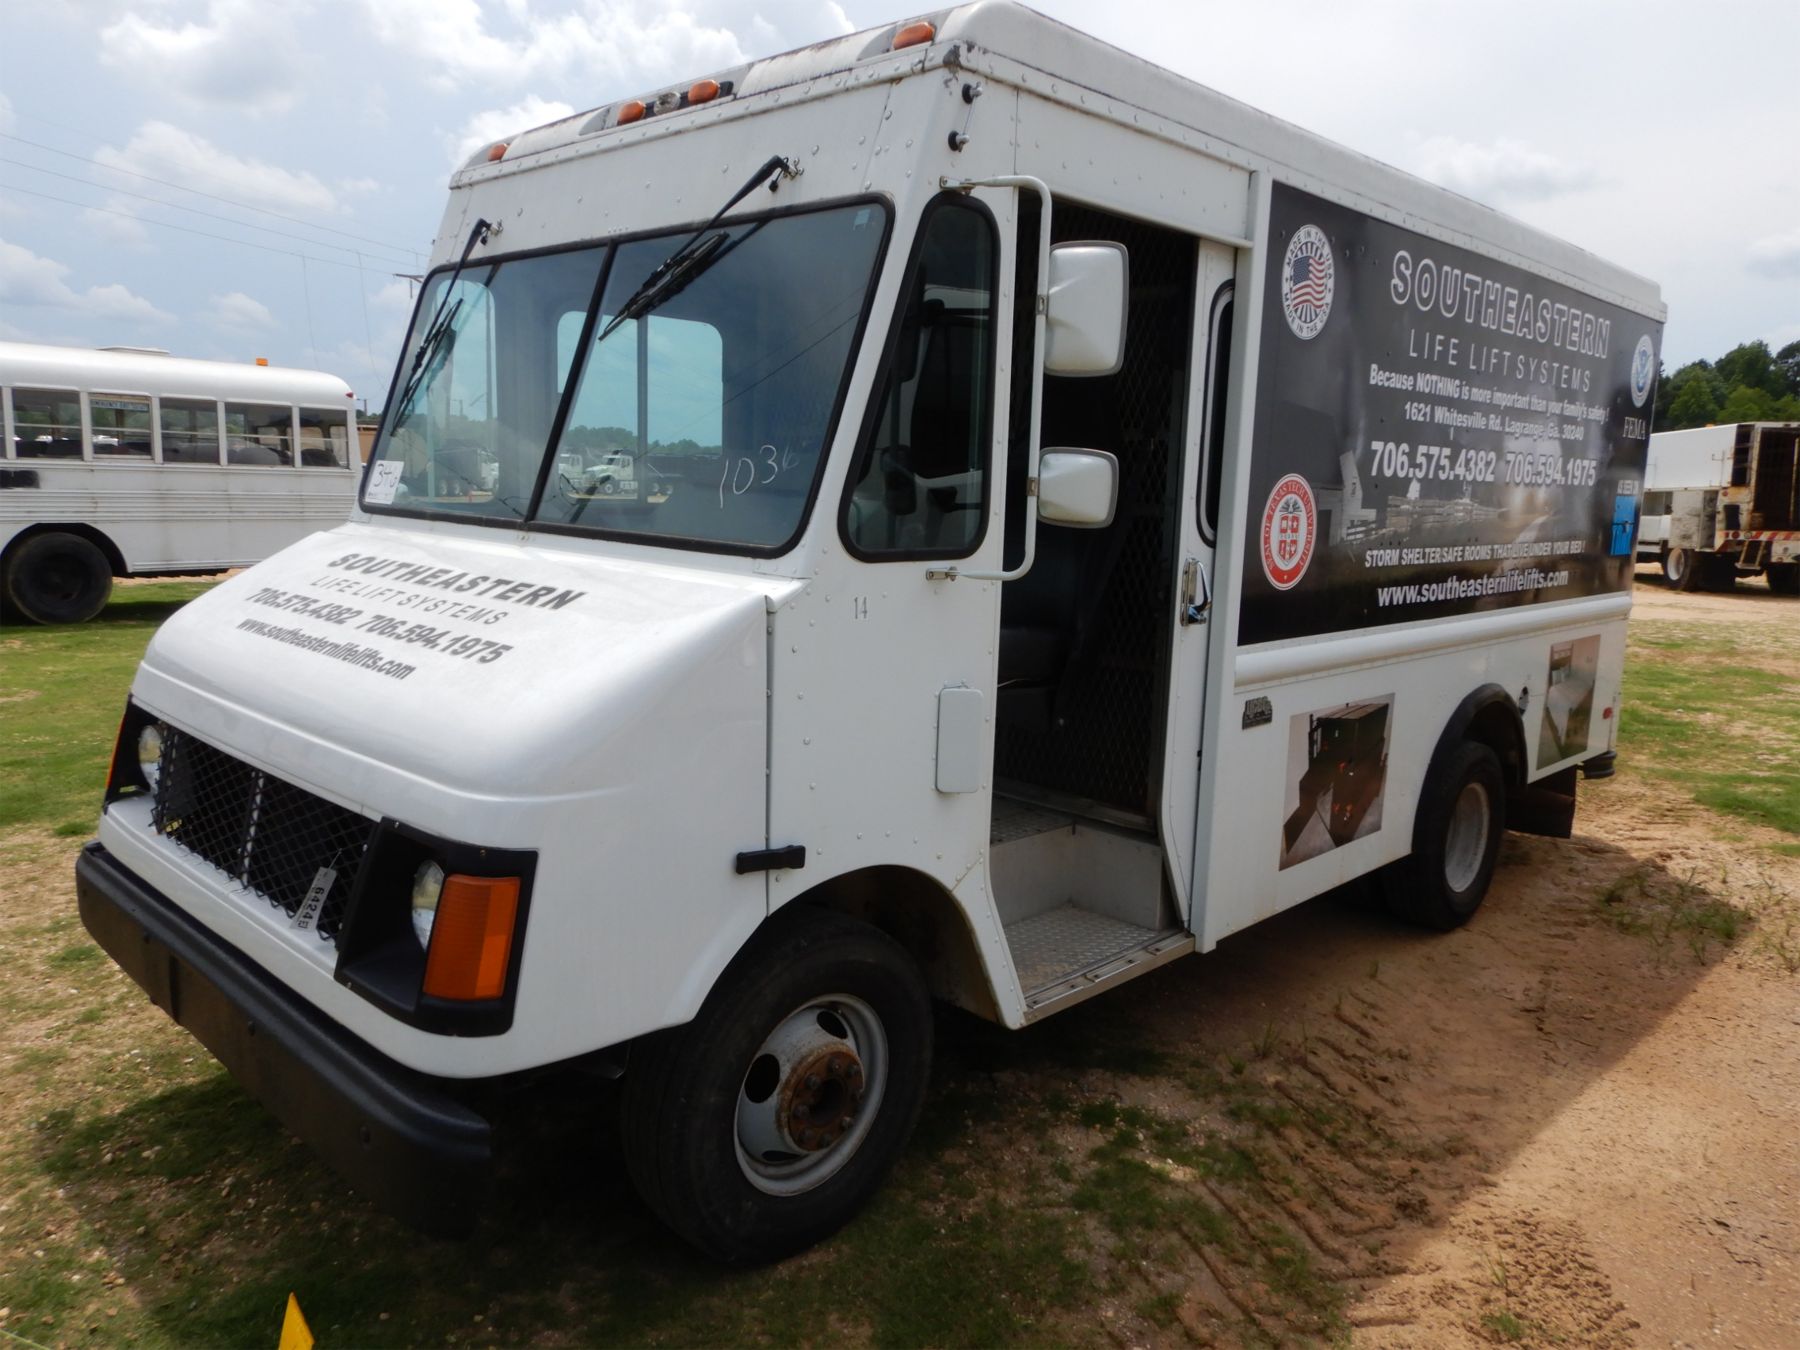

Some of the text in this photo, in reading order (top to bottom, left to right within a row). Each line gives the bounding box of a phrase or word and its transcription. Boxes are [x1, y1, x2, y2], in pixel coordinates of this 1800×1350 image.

[1390, 250, 1611, 359] SOUTHEASTERN
[1409, 329, 1459, 366] LIFE
[1469, 343, 1511, 376] LIFT
[1516, 354, 1591, 393] SYSTEMS
[1369, 363, 1414, 391] Because
[1416, 372, 1461, 399] NOTHING
[1461, 382, 1470, 401] is
[1470, 387, 1492, 405] more
[1492, 386, 1530, 410] important
[1530, 394, 1547, 412] than
[1404, 401, 1431, 422] 1621
[1434, 405, 1487, 430] Whitesville
[1488, 414, 1503, 432] Rd.
[1622, 416, 1646, 440] FEMA
[1371, 440, 1598, 487] 706.575.4382 706.594.1975
[1365, 549, 1399, 568] STORM
[1401, 547, 1442, 565] SHELTER
[1442, 546, 1464, 563] SAFE
[1464, 545, 1492, 561] ROOMS
[1493, 543, 1513, 559] THAT
[327, 553, 588, 611] SOUTHEASTERN
[1377, 569, 1569, 607] www.southeasternlifelifts.com
[245, 587, 515, 665] 706.575.4382 706.594.1975
[397, 594, 509, 625] SYSTEMS
[854, 596, 868, 620] 14
[235, 618, 417, 680] www.southeasternlifelifts.com
